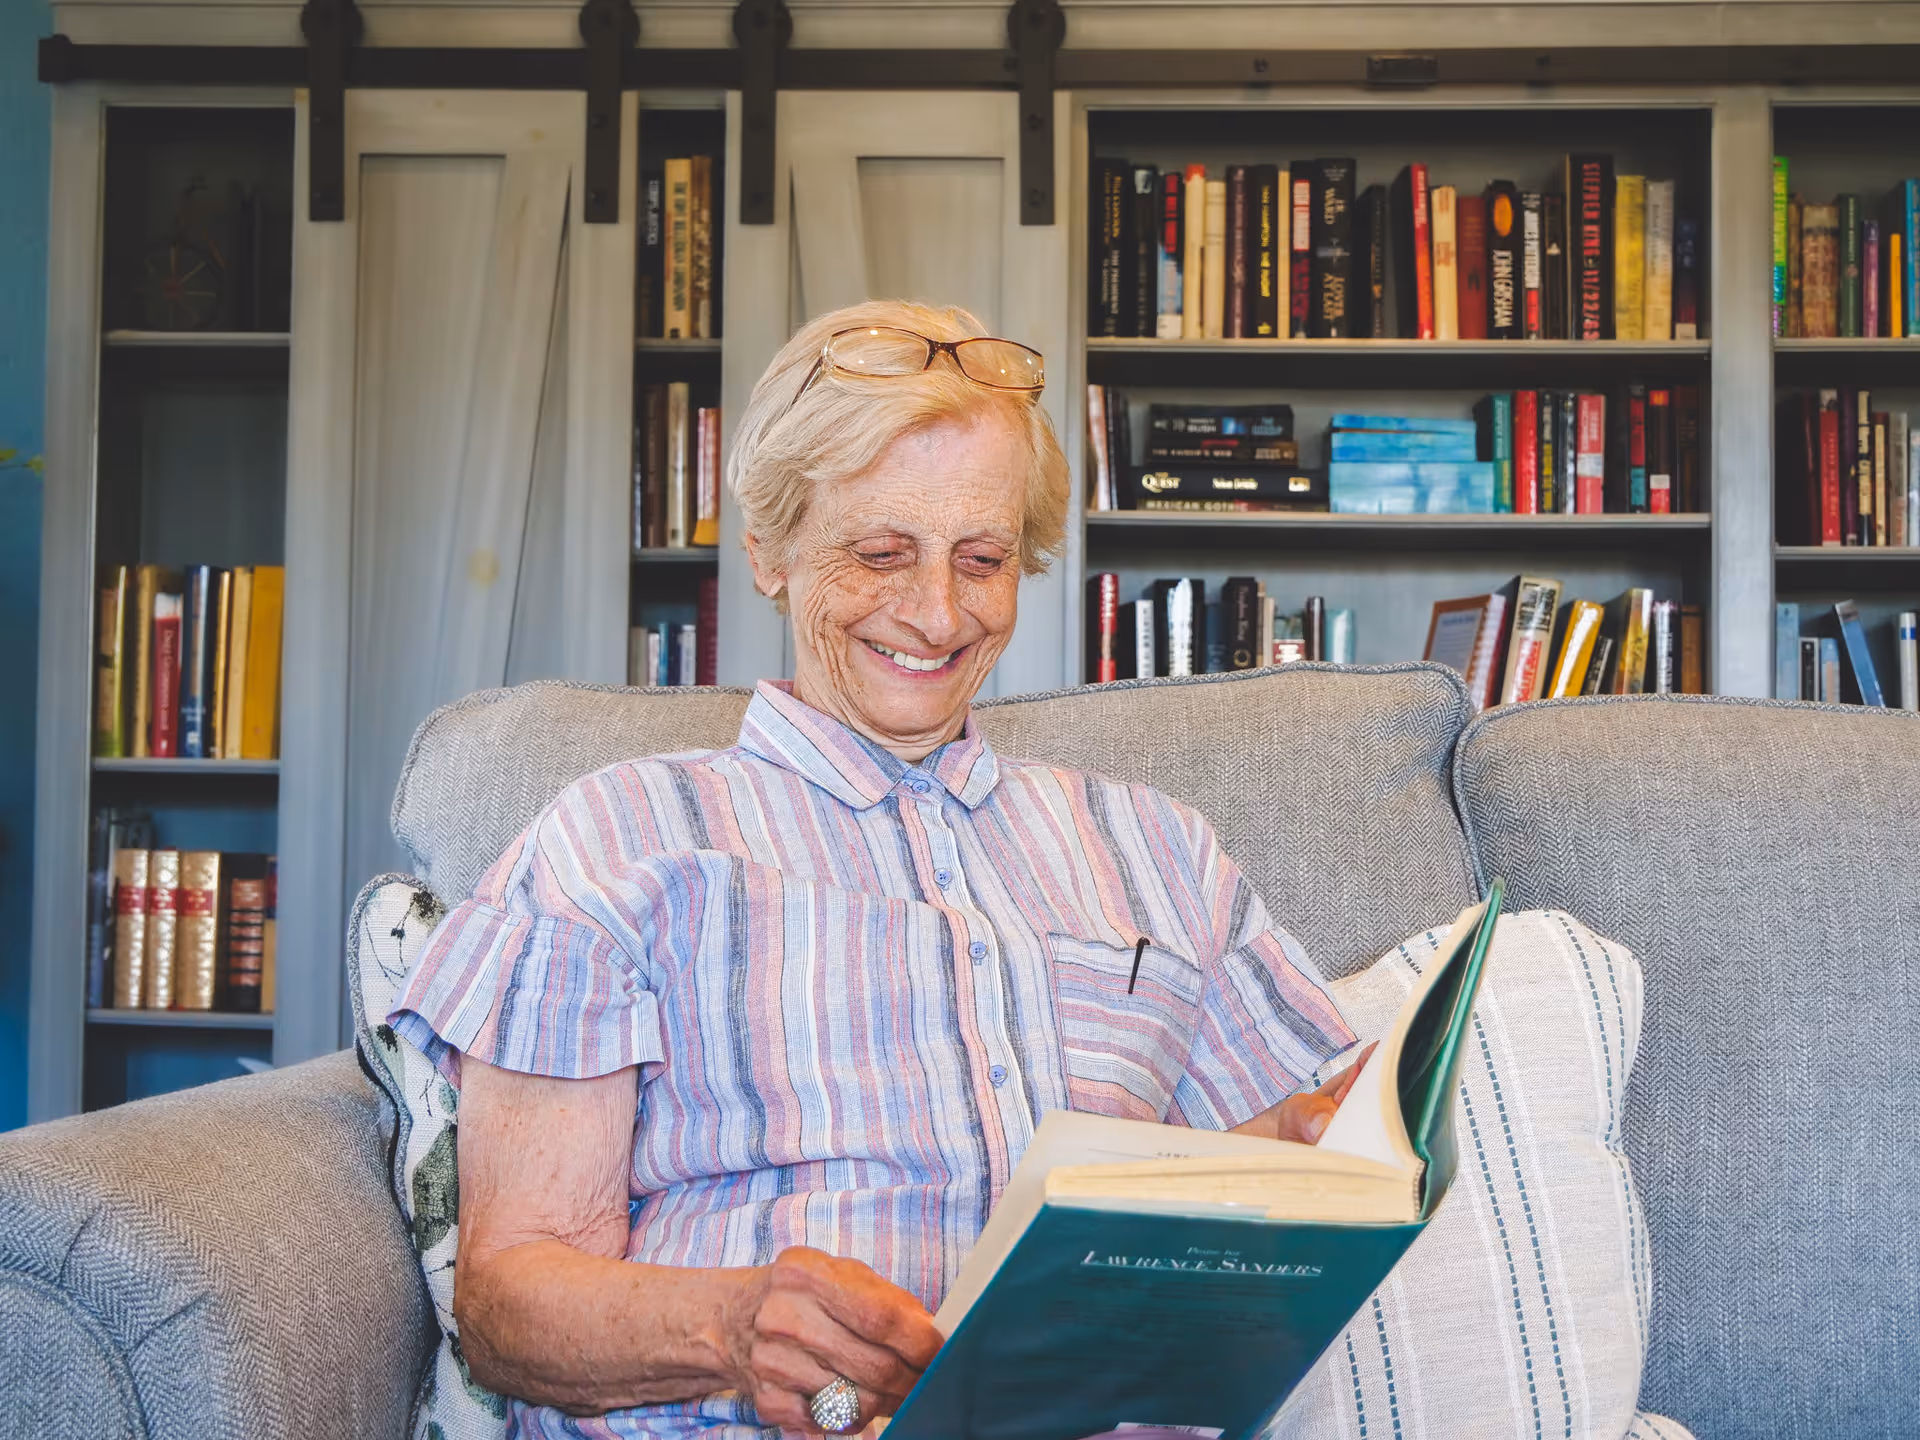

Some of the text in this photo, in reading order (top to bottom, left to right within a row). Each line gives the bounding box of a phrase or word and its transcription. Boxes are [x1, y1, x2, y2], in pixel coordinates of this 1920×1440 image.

[1582, 162, 1601, 340] STEPHEN KING 11/22/63
[1492, 278, 1513, 328] GRISHAM
[1080, 1250, 1324, 1275] LAWRENCE SANDERS
